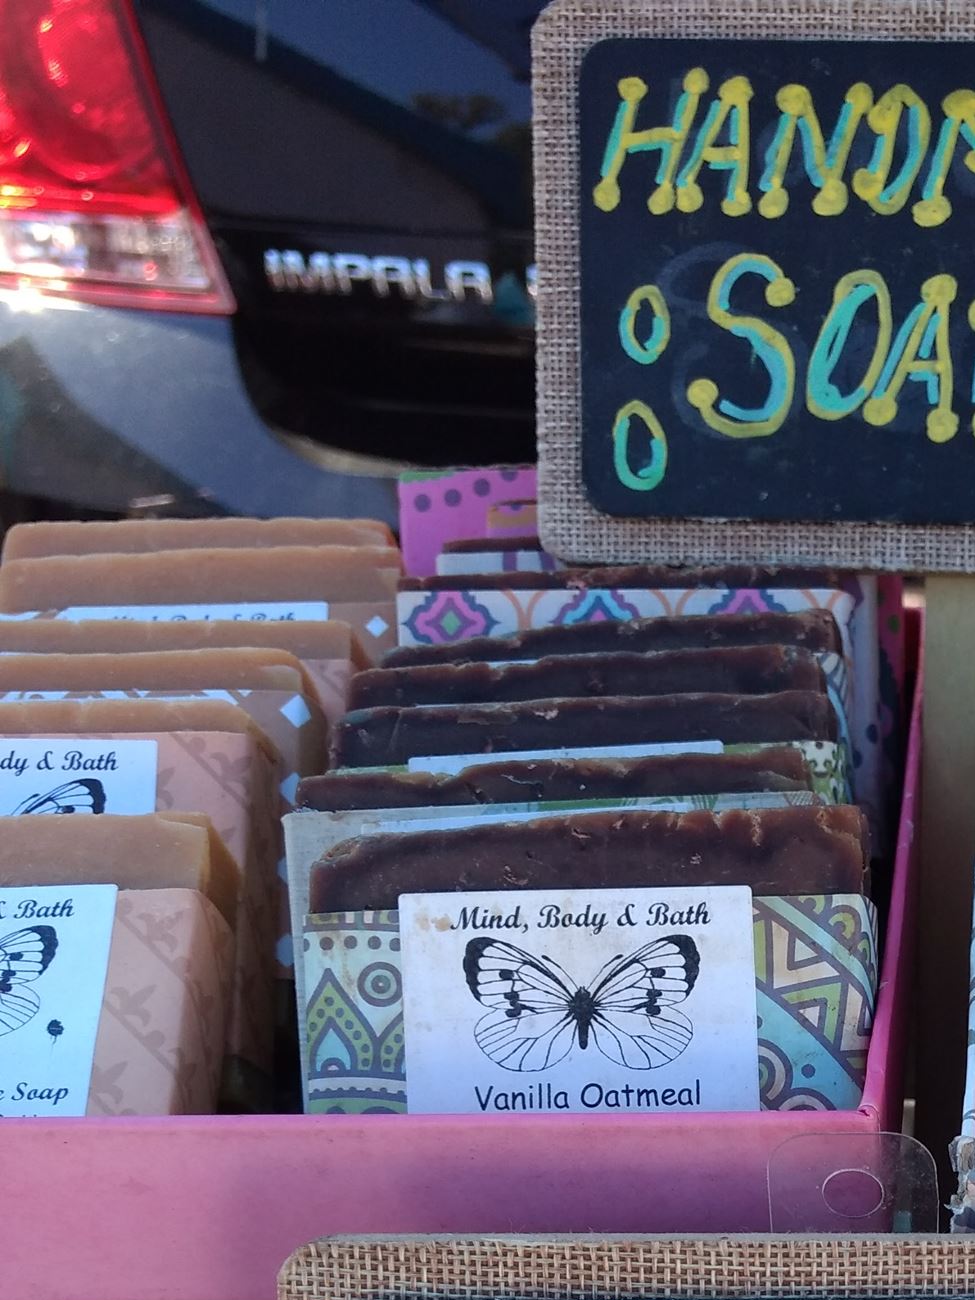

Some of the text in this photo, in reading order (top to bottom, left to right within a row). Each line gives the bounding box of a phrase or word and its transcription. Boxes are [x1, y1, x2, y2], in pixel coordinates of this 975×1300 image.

[263, 248, 494, 303] IMPALA
[37, 751, 54, 770] &
[61, 750, 118, 771] Bath
[14, 899, 74, 919] Bath
[450, 902, 711, 935] Mind, Body & Bath
[11, 1082, 69, 1105] Soap
[474, 1079, 701, 1111] Vanilla Oatmeal
